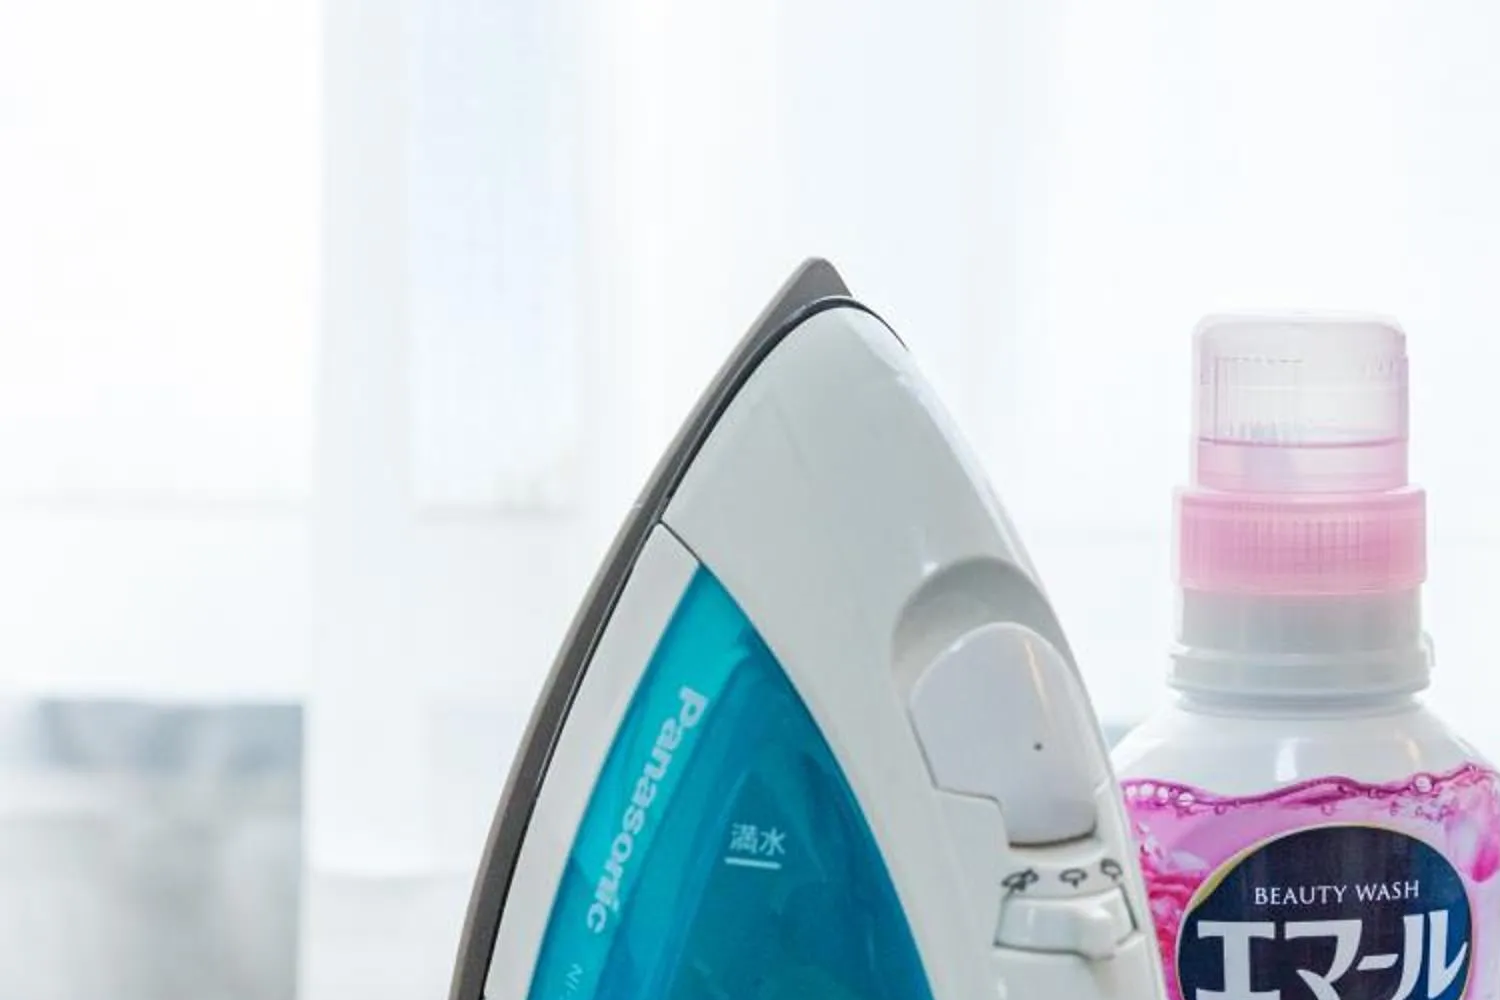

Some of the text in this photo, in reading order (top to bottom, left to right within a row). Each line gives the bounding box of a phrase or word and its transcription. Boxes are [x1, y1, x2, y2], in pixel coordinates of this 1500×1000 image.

[587, 685, 709, 933] Panasonic
[729, 822, 786, 856] 満水
[1254, 879, 1420, 905] BEAUTY WASH
